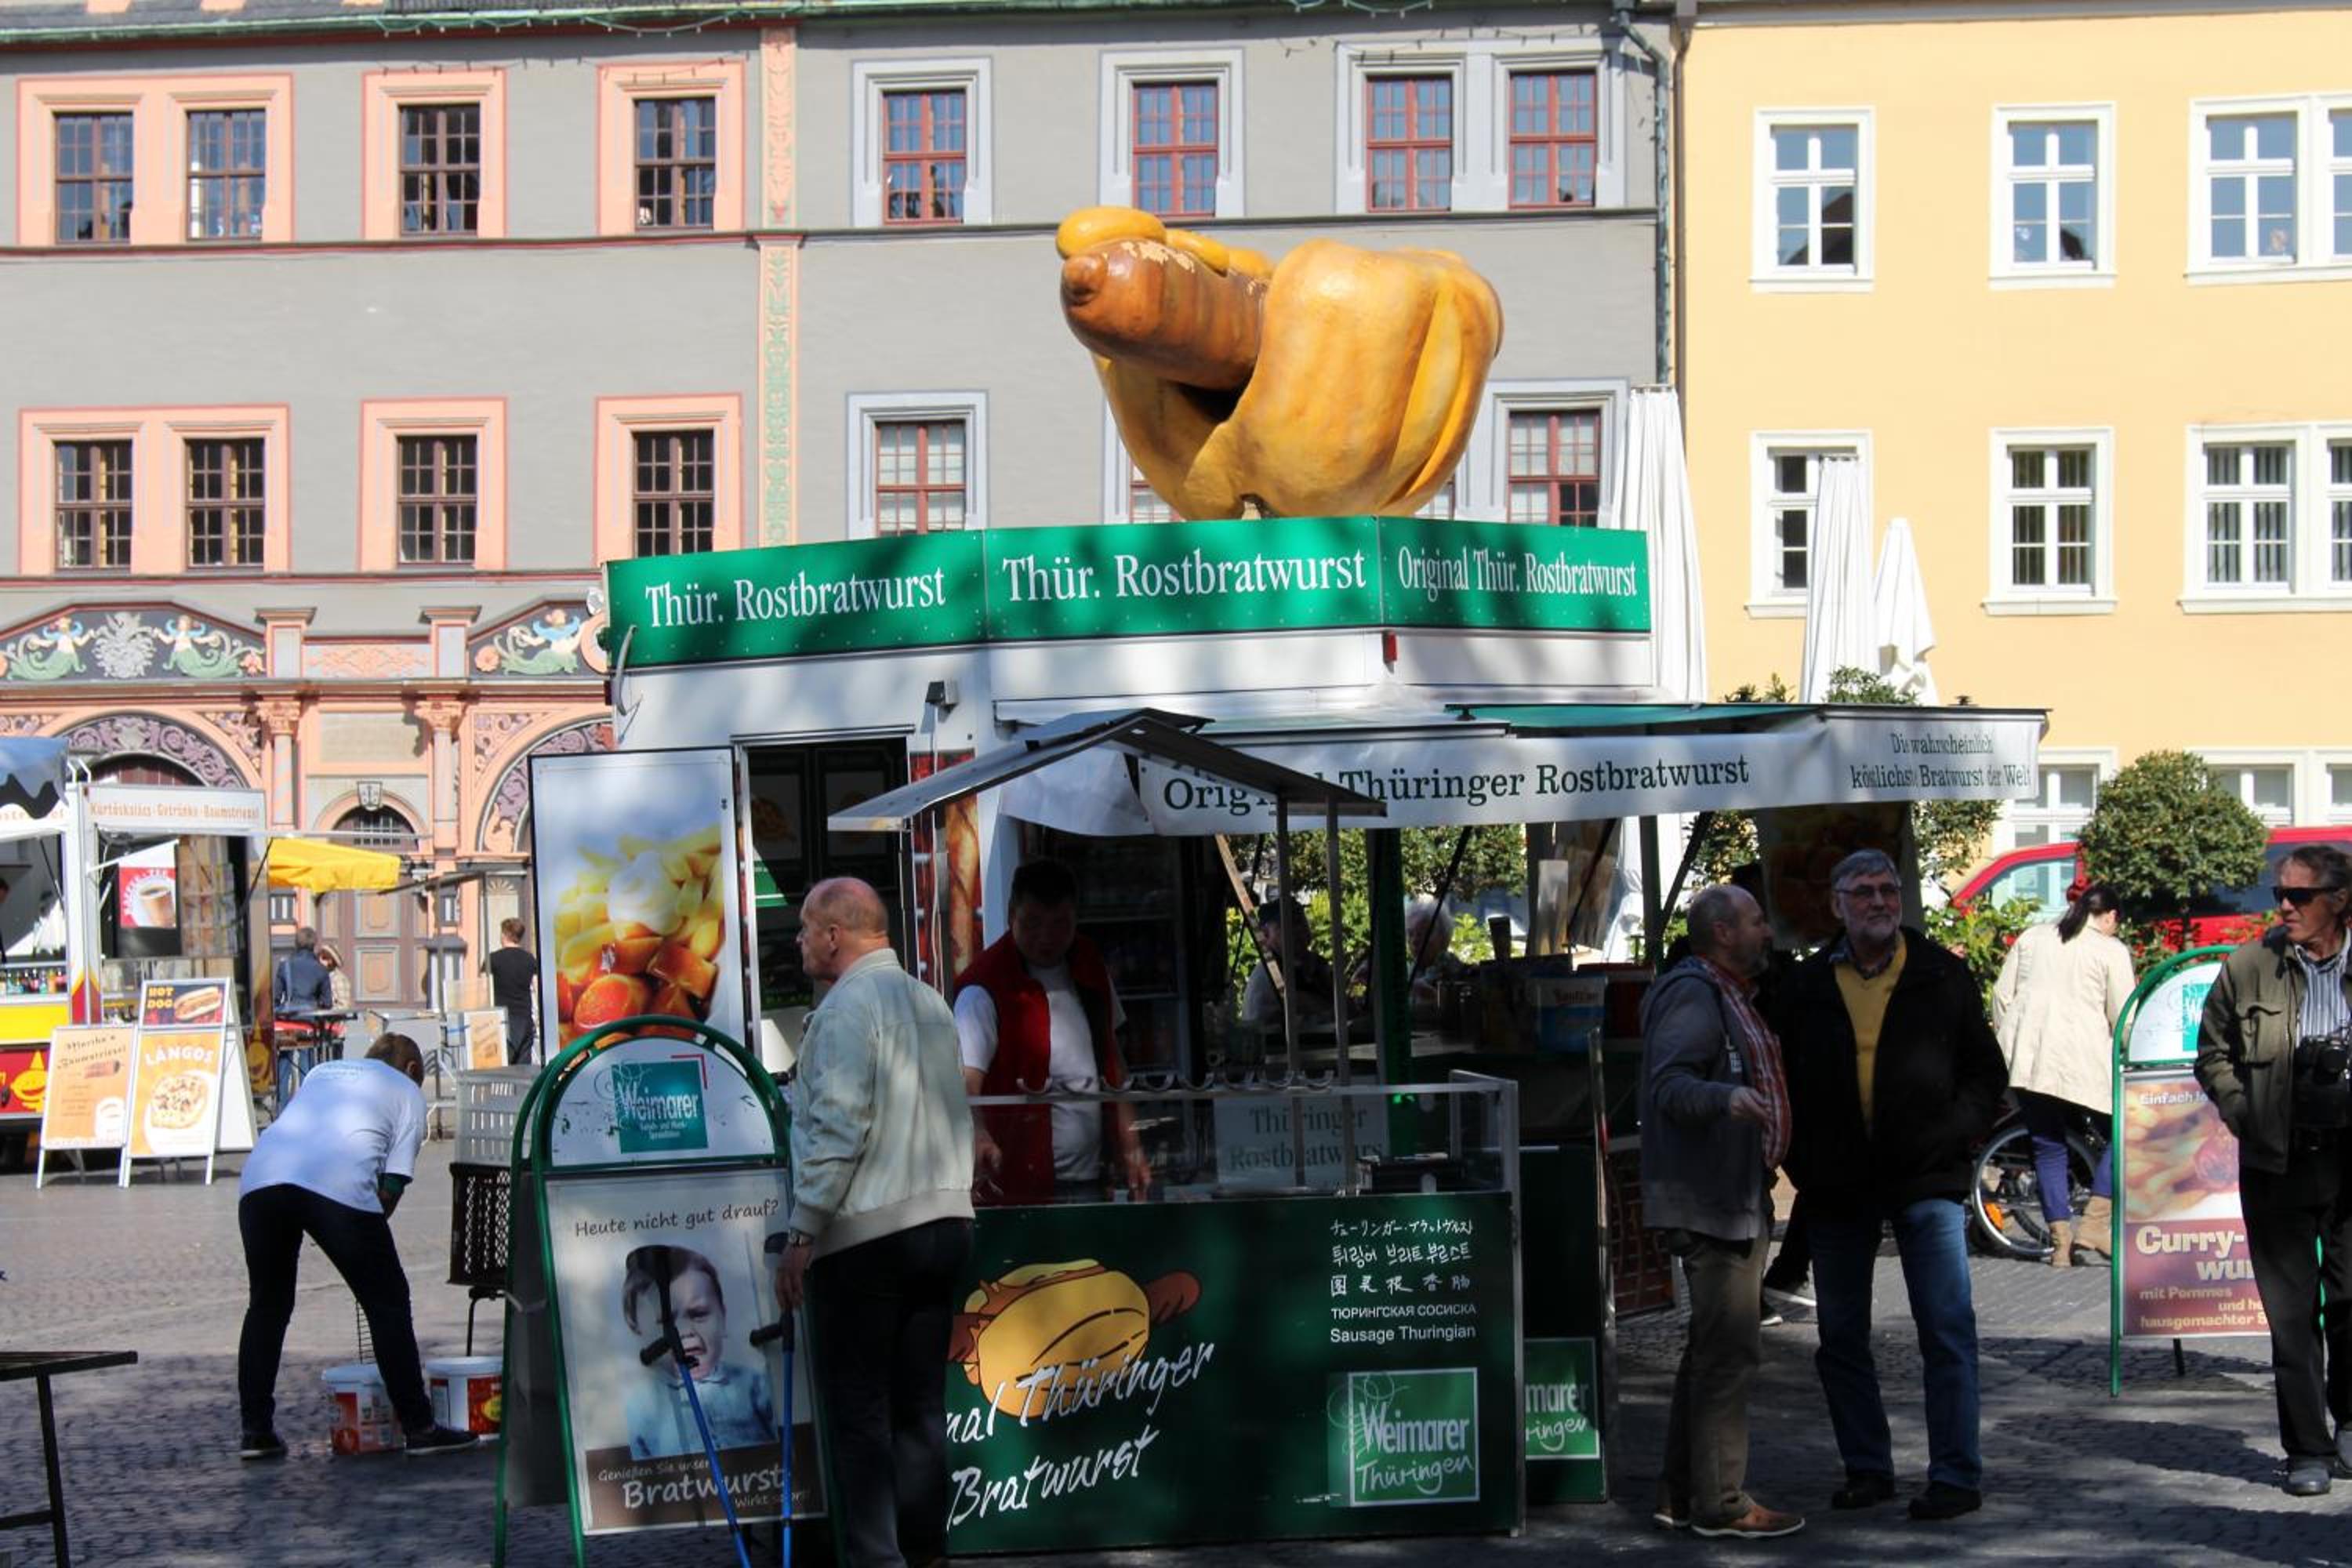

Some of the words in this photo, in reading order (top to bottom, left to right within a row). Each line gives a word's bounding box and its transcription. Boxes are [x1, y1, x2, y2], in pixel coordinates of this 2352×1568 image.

[1003, 557, 1100, 602] Thür.
[1114, 549, 1366, 598] Rostbratwurst
[1398, 546, 1469, 604] Original
[1473, 549, 1519, 593] Thür.
[1524, 551, 1637, 597] Rostbratwurst
[645, 582, 724, 628] Thür.
[735, 565, 946, 622] Rostbratwurst
[1338, 764, 1525, 807] Thüringer
[1537, 754, 1750, 793] Rostbratwurst
[1918, 764, 1983, 787] Bratwurst
[2004, 765, 2031, 786] Welt
[147, 998, 173, 1009] DOG
[149, 986, 174, 997] HOT
[615, 1076, 699, 1121] Weimarer
[2140, 1091, 2193, 1104] Einfach
[575, 1221, 627, 1237] Heute
[634, 1211, 678, 1230] nicht
[685, 1210, 715, 1230] gut
[722, 1200, 779, 1220] drauf?
[2136, 1225, 2245, 1259] Curry-
[1331, 1305, 1415, 1319] ТЮРИНГСКАЯ
[1417, 1303, 1477, 1316] СОСИСКА
[2140, 1287, 2166, 1300] mit
[2169, 1286, 2233, 1300] Pommes
[2218, 1299, 2245, 1312] und
[1330, 1328, 1395, 1345] Sausage
[1399, 1323, 1476, 1341] Thuringian
[2140, 1313, 2255, 1330] hausgemachter
[1016, 1342, 1214, 1428] Thüringer
[1525, 1383, 1590, 1414] marer
[1359, 1401, 1470, 1454] Weimarer
[1525, 1417, 1592, 1453] ringen
[623, 1463, 785, 1509] Bratwurst
[946, 1424, 1160, 1532] Bratwurst
[1355, 1454, 1475, 1495] Thüringen
